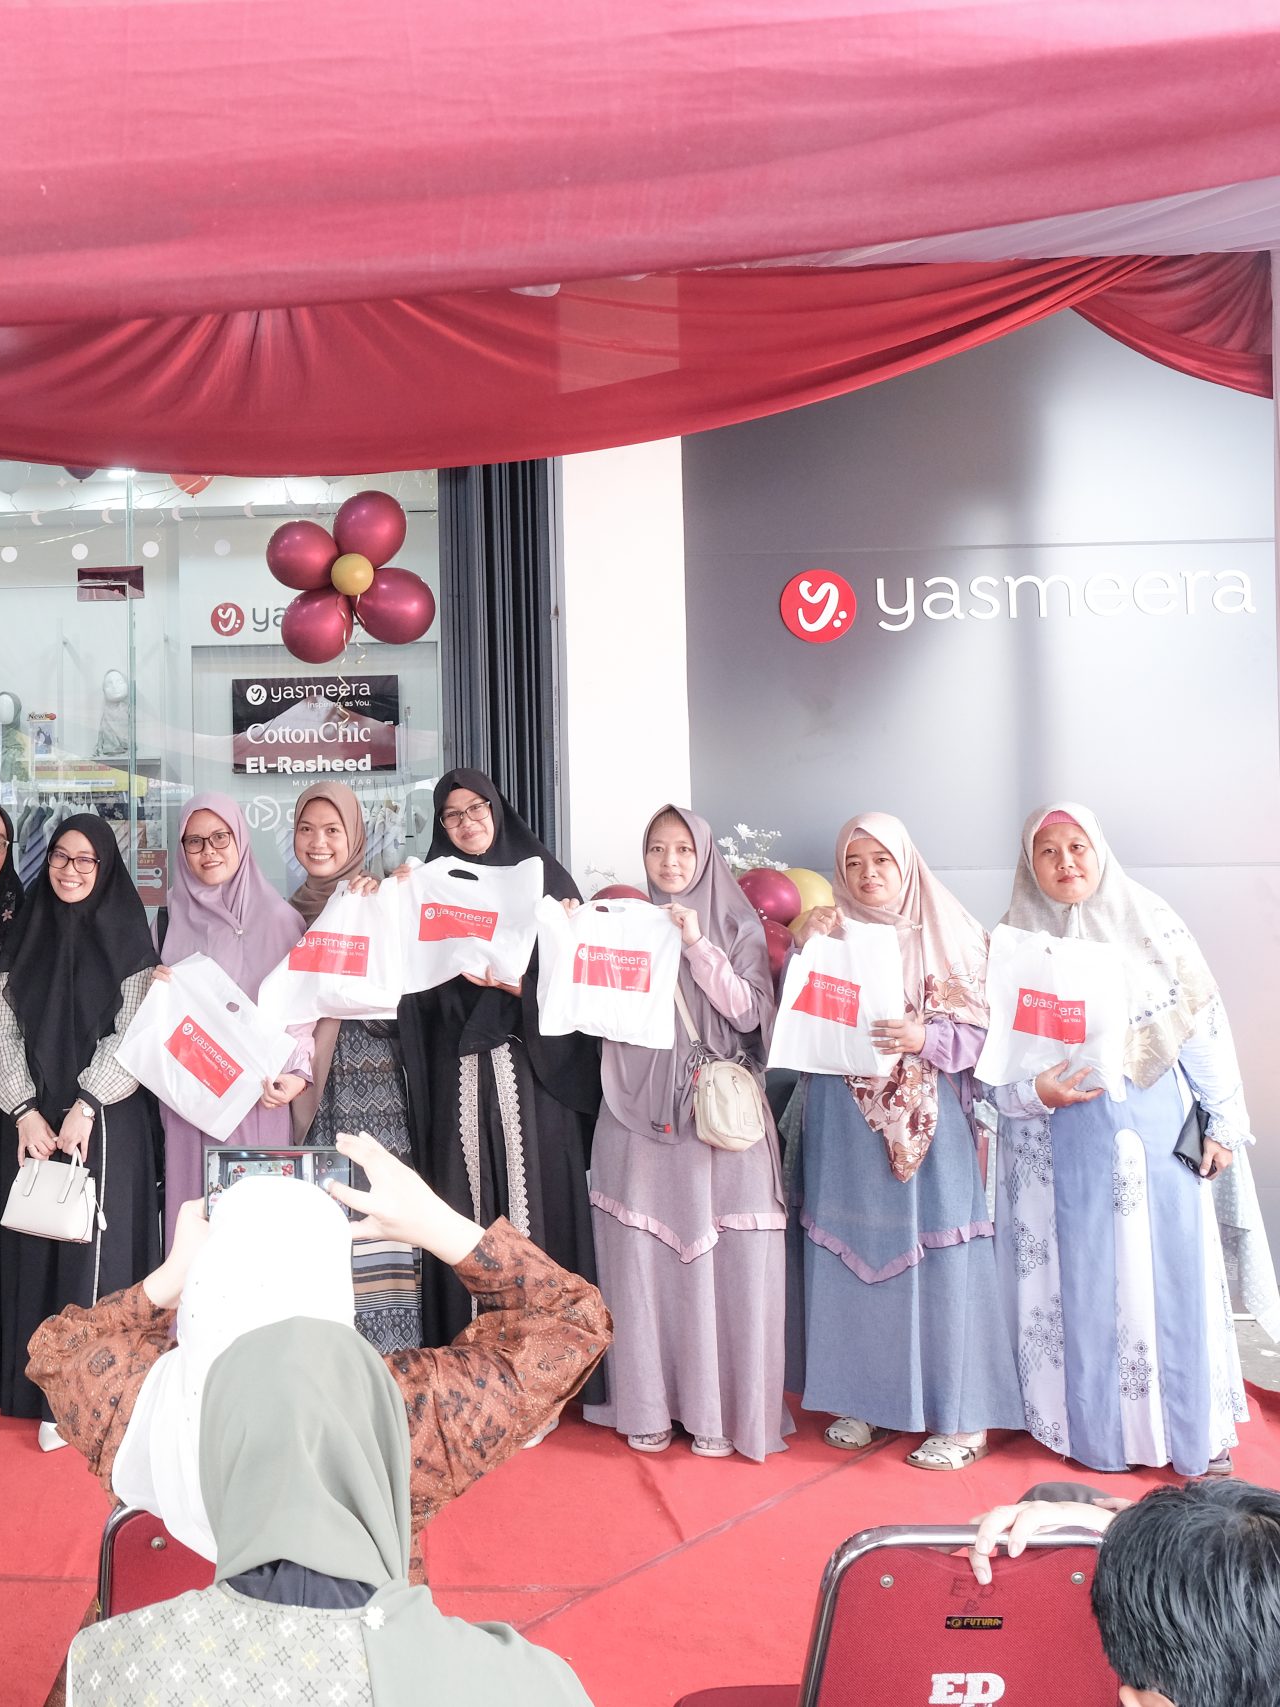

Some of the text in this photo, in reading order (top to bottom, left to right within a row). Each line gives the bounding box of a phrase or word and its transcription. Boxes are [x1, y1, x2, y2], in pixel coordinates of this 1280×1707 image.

[876, 567, 1257, 632] yasmeera
[270, 682, 371, 703] yasmeera
[246, 721, 371, 744] CottonChic
[245, 754, 371, 774] El-Rasheed
[436, 907, 493, 924] yasmeera
[308, 937, 365, 950] yasmeera
[190, 1032, 237, 1077] yasmeera
[963, 1618, 999, 1626] FUTURA
[928, 1672, 1006, 1704] ED
